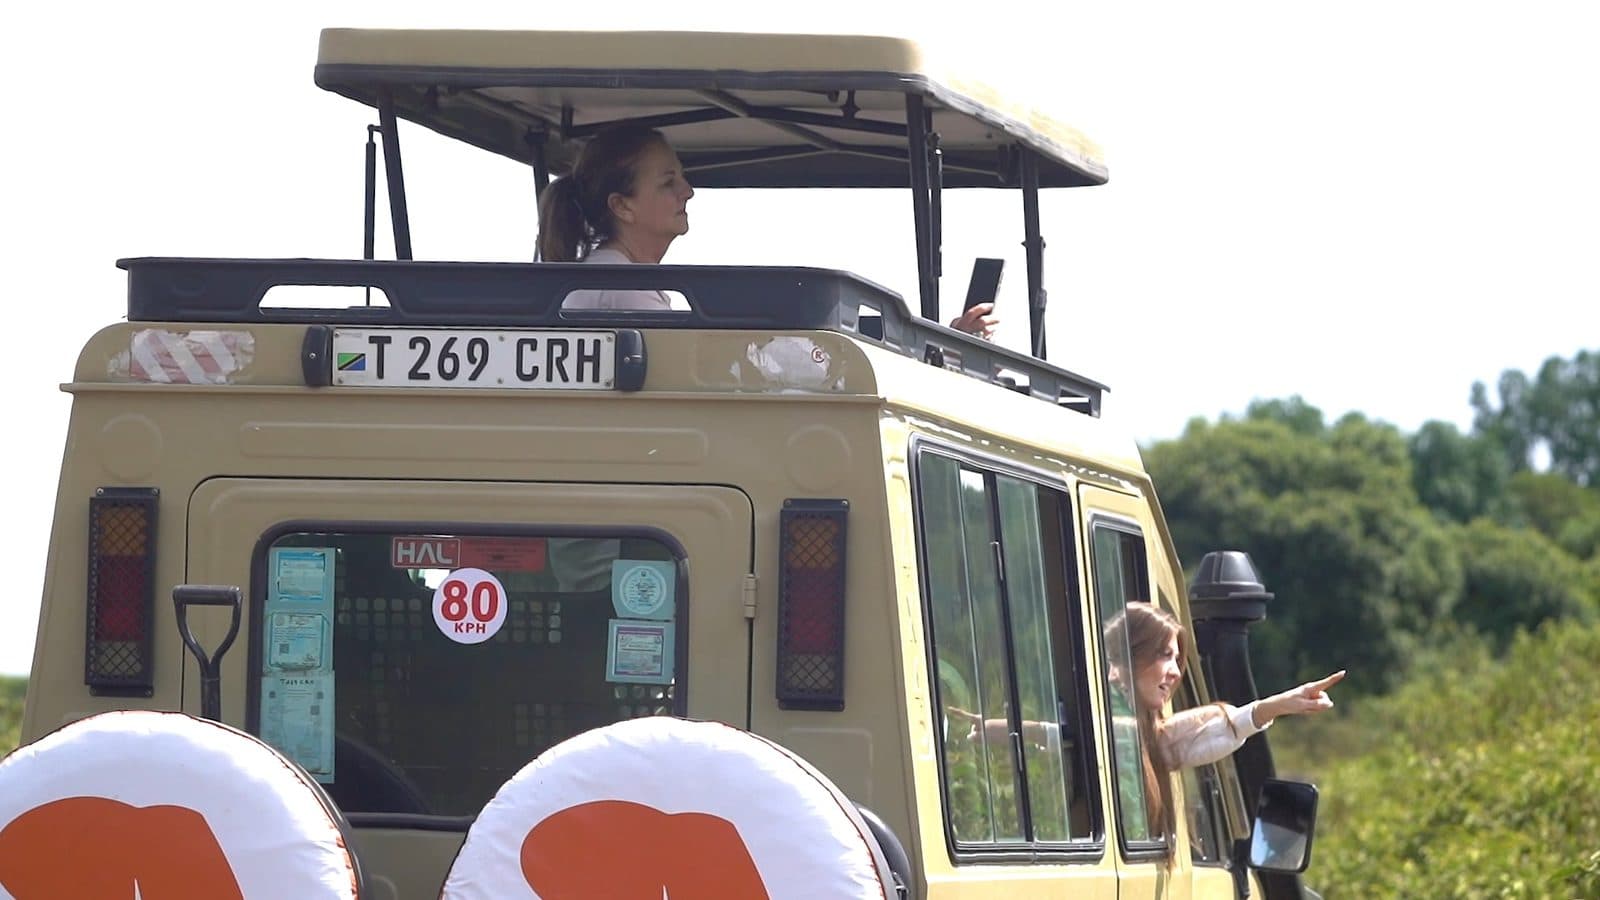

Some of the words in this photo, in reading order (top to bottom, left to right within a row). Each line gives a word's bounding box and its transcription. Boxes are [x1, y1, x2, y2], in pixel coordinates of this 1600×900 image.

[368, 335, 392, 380] T
[408, 336, 490, 381] 269
[515, 338, 601, 383] CRH
[397, 541, 453, 564] HAL
[441, 579, 498, 622] 80
[454, 622, 486, 634] KPH
